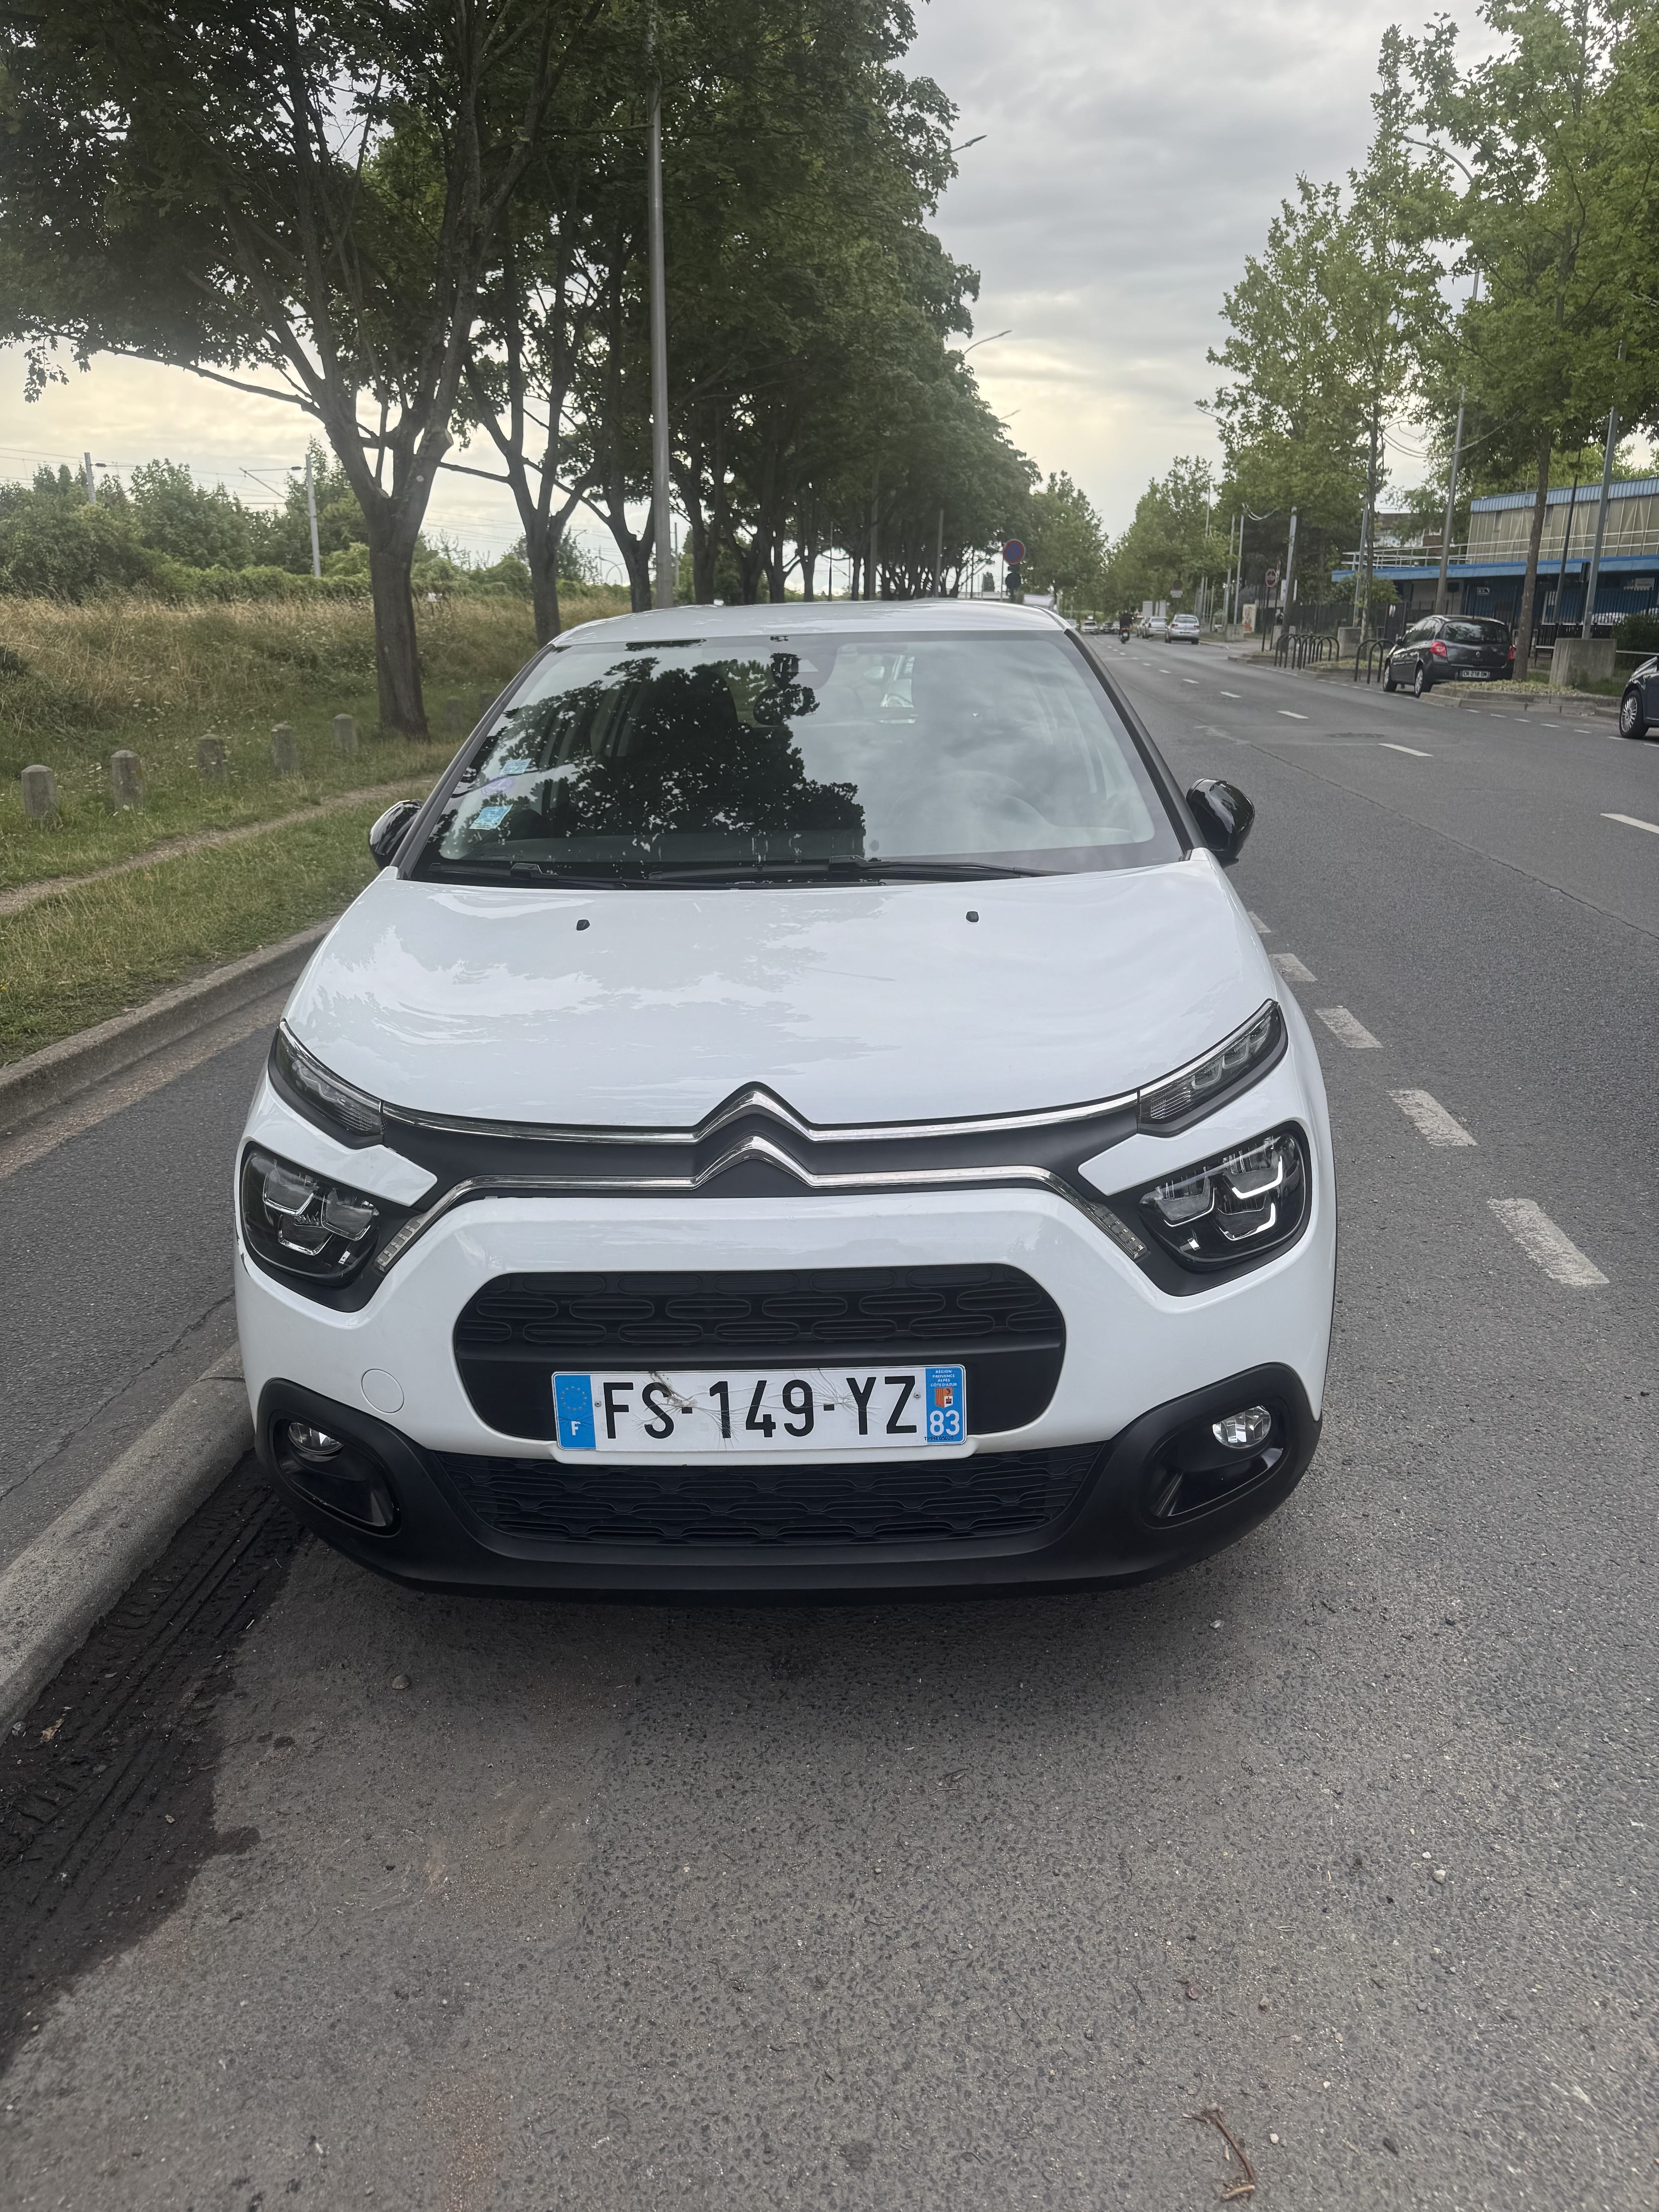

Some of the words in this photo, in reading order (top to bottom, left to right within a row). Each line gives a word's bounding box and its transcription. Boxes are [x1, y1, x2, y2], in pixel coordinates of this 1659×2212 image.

[603, 1376, 917, 1439] FS-149-YZ
[571, 1421, 581, 1436] F
[930, 1410, 960, 1436] 83
